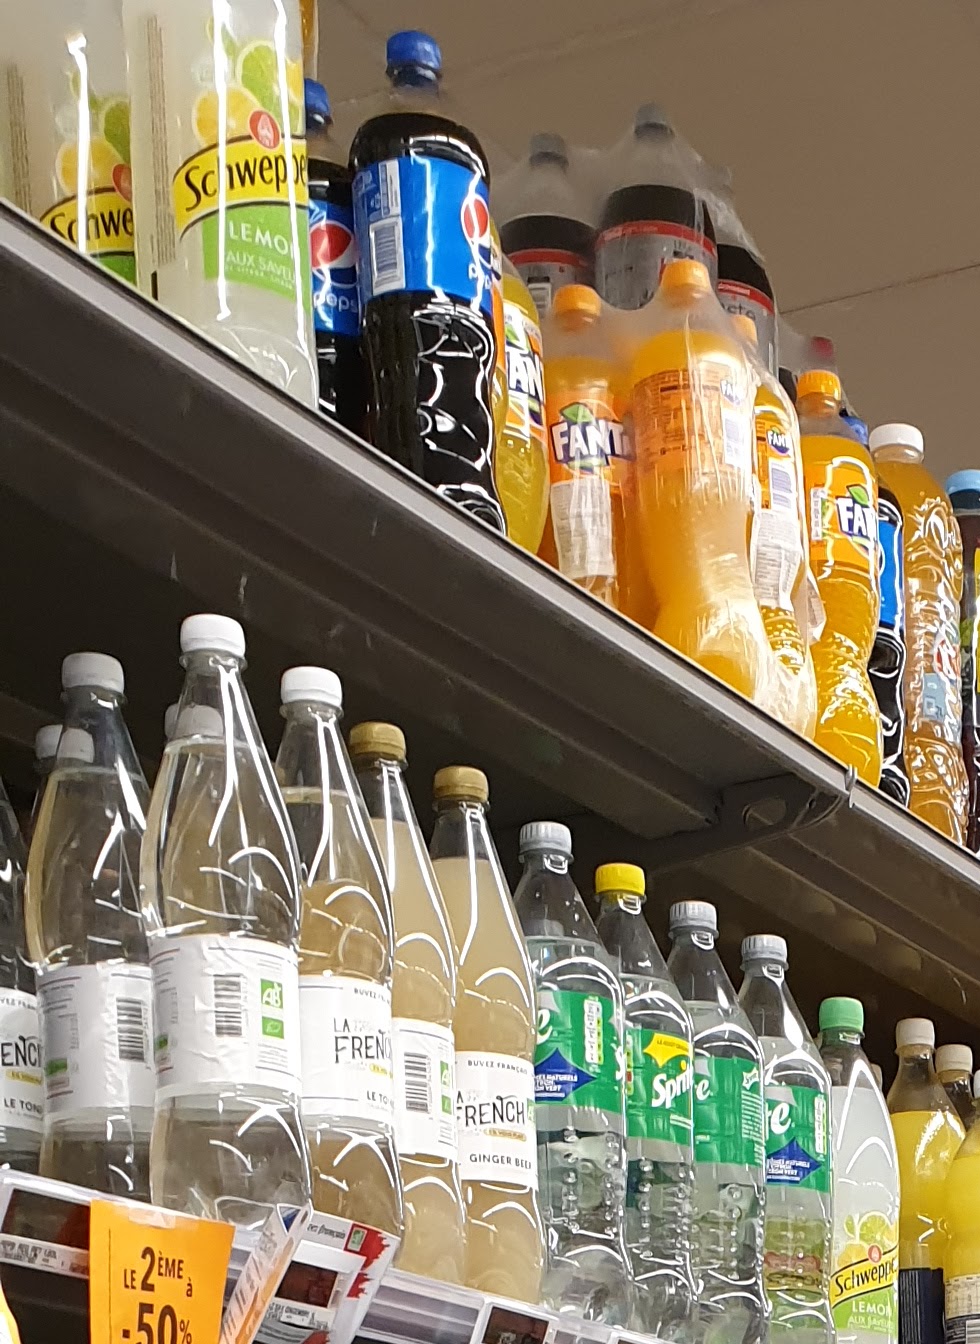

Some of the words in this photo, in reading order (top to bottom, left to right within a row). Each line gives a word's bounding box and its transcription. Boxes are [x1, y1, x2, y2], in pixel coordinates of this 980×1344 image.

[333, 1017, 351, 1033] LA
[1, 1034, 42, 1067] ENC
[469, 1152, 506, 1167] GINGER
[123, 1267, 137, 1290] LE
[185, 1278, 194, 1298] à
